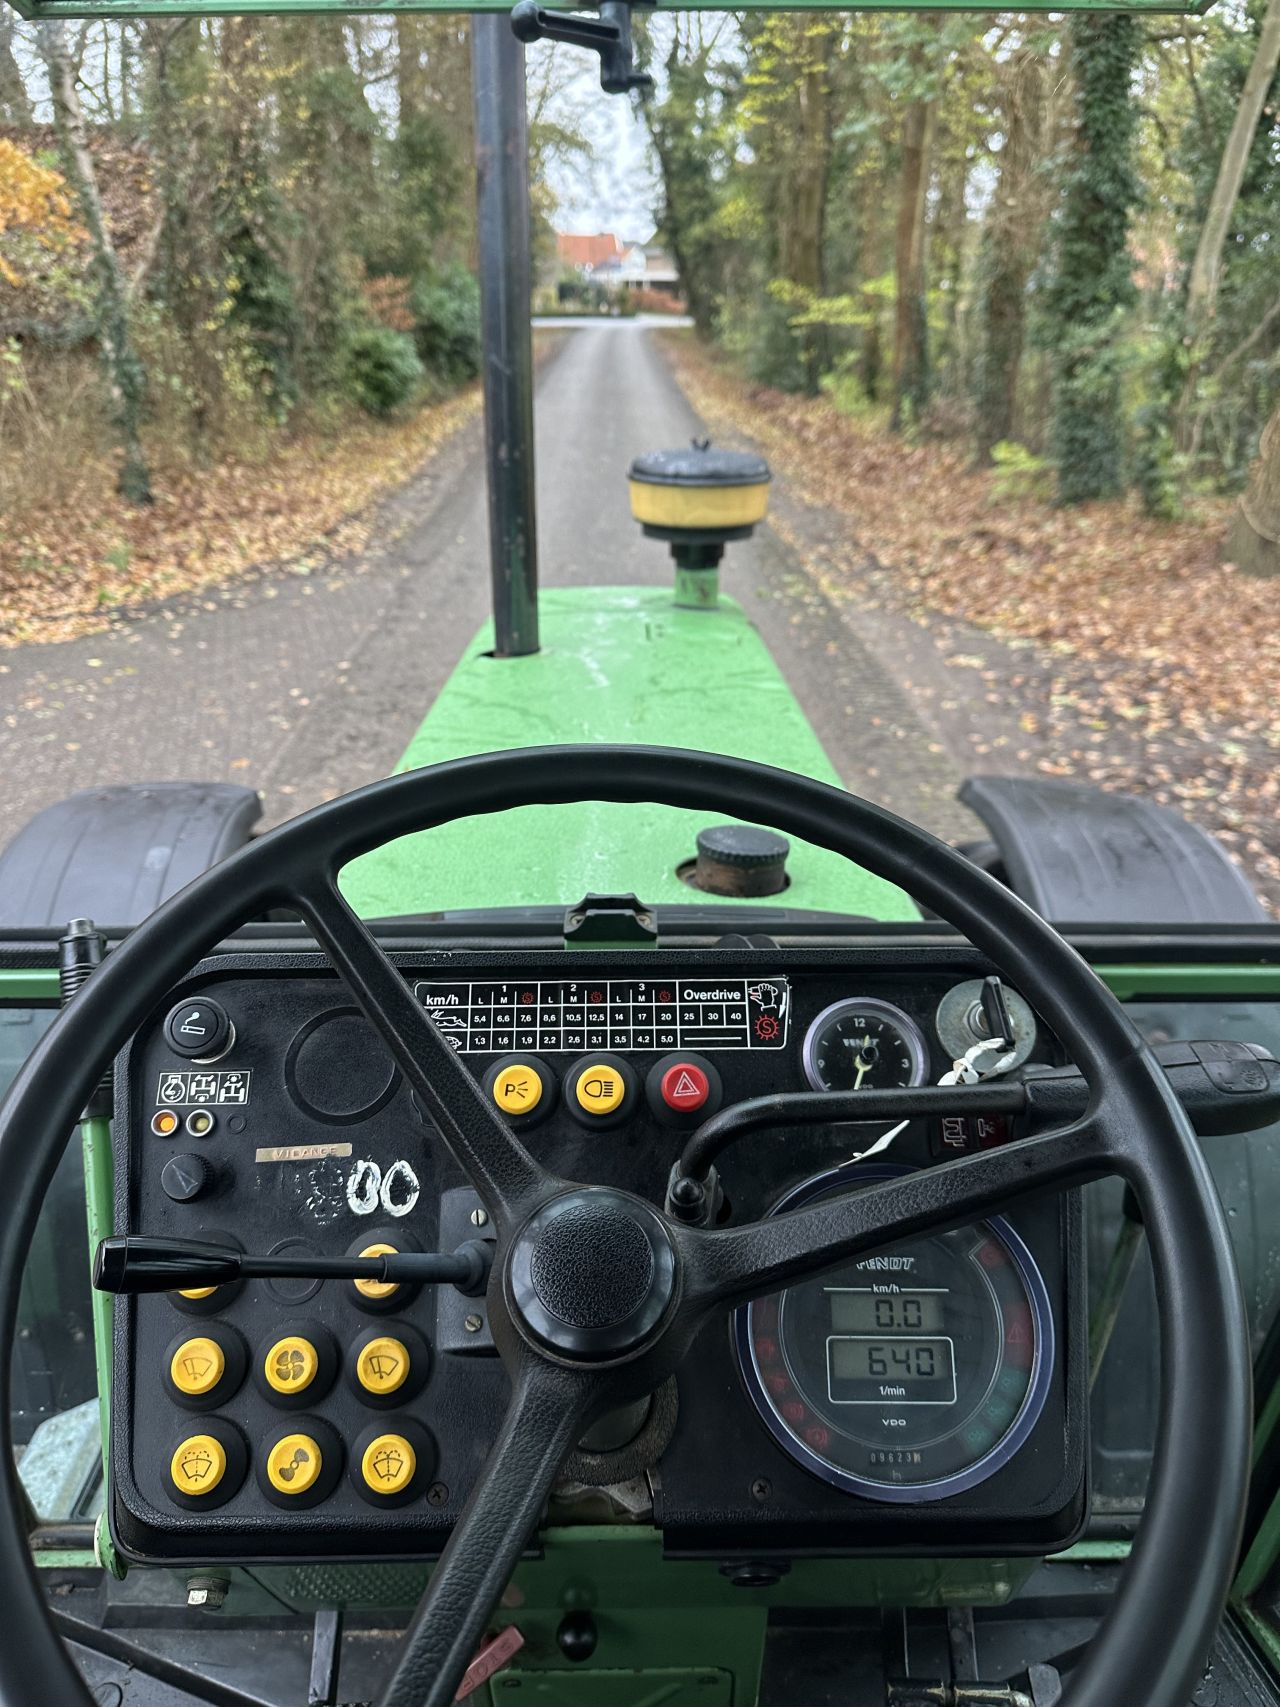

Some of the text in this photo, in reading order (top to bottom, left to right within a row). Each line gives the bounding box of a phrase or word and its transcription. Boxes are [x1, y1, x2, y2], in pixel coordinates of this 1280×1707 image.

[501, 982, 647, 993] 1 2 3
[425, 994, 460, 1006] km/h
[478, 997, 484, 1005] L
[500, 996, 508, 1005] M
[548, 996, 554, 1004] L
[570, 995, 578, 1003] M
[616, 995, 622, 1003] L
[637, 995, 647, 1003] M
[683, 989, 742, 1001] Overdrive
[473, 1012, 742, 1023] 5,4 6,6 7,6 8,6 10,5 12,5 14 17 20 25 30 40
[854, 1018, 866, 1027] 12
[474, 1037, 486, 1046] 1,3
[497, 1036, 509, 1046] 1,6
[521, 1036, 534, 1045] 1,9
[543, 1036, 556, 1045] 2,2
[568, 1035, 581, 1044] 2,6
[591, 1035, 602, 1045] 3,1
[614, 1035, 627, 1044] 3,5
[817, 1059, 825, 1069] 9
[901, 1058, 909, 1069] 3
[505, 1083, 516, 1097] P
[873, 1284, 900, 1294] km/h
[875, 1299, 922, 1328] 0.0
[868, 1347, 935, 1376] 640
[879, 1386, 906, 1396] 1/min
